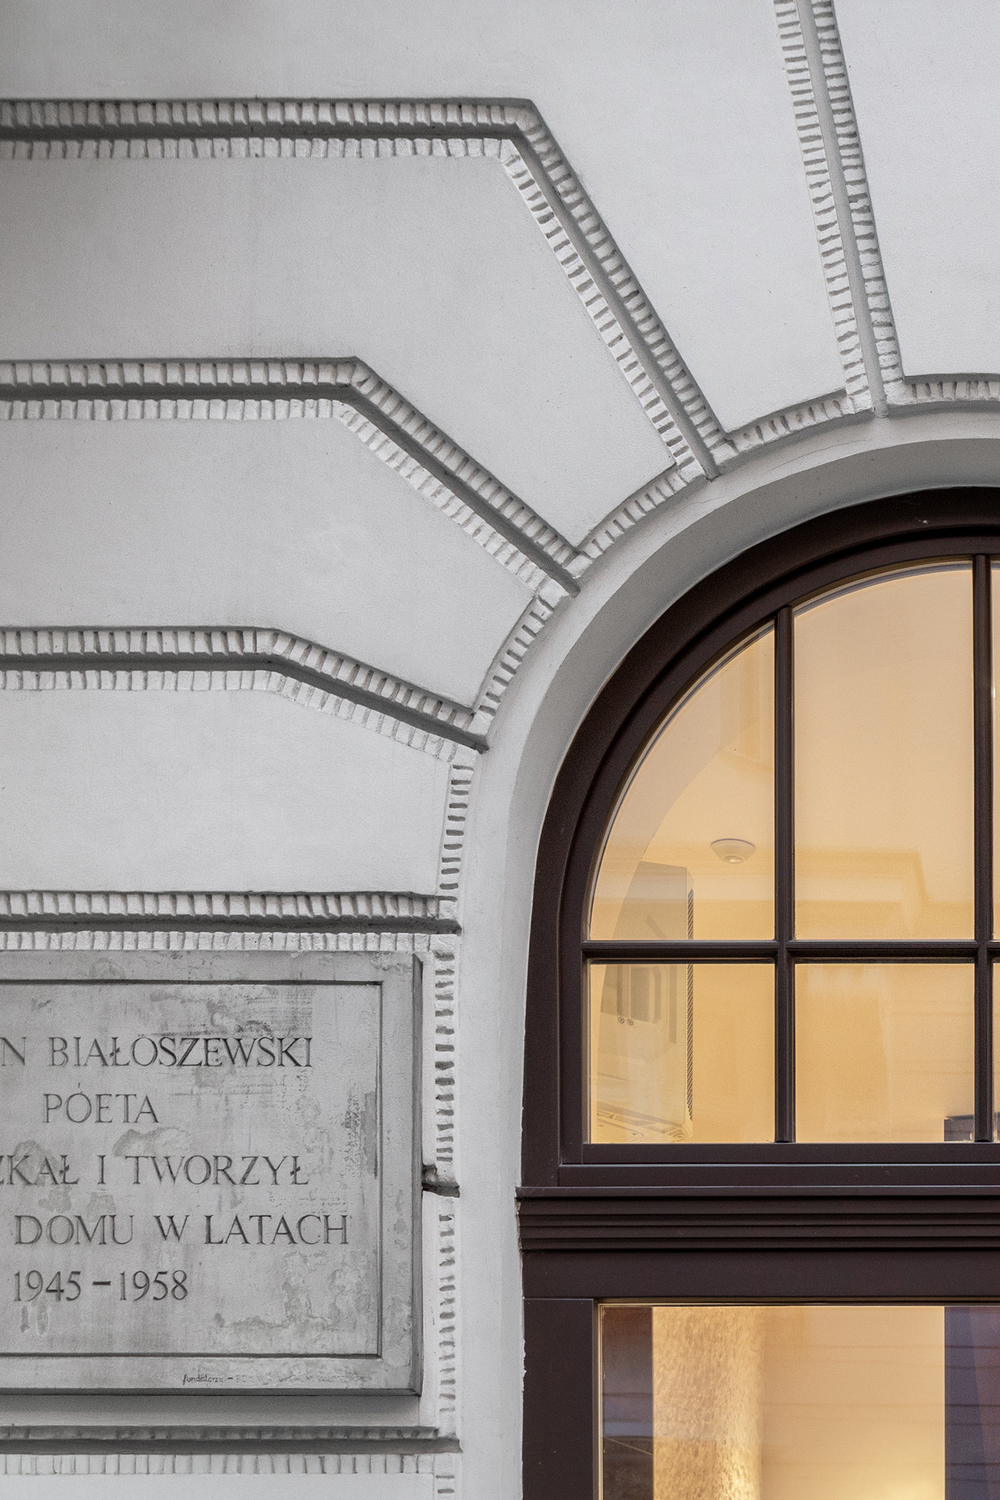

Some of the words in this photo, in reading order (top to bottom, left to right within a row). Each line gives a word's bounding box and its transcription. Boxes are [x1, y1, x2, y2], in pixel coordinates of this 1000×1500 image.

[48, 1036, 313, 1068] BIAŁOSZEWSKI
[42, 1092, 160, 1123] POETA
[0, 1154, 80, 1185] KAŁ
[97, 1154, 106, 1185] I
[125, 1154, 310, 1185] TWORZYŁ
[14, 1214, 134, 1245] DOMU
[153, 1214, 190, 1242] W
[204, 1213, 349, 1245] LATACH
